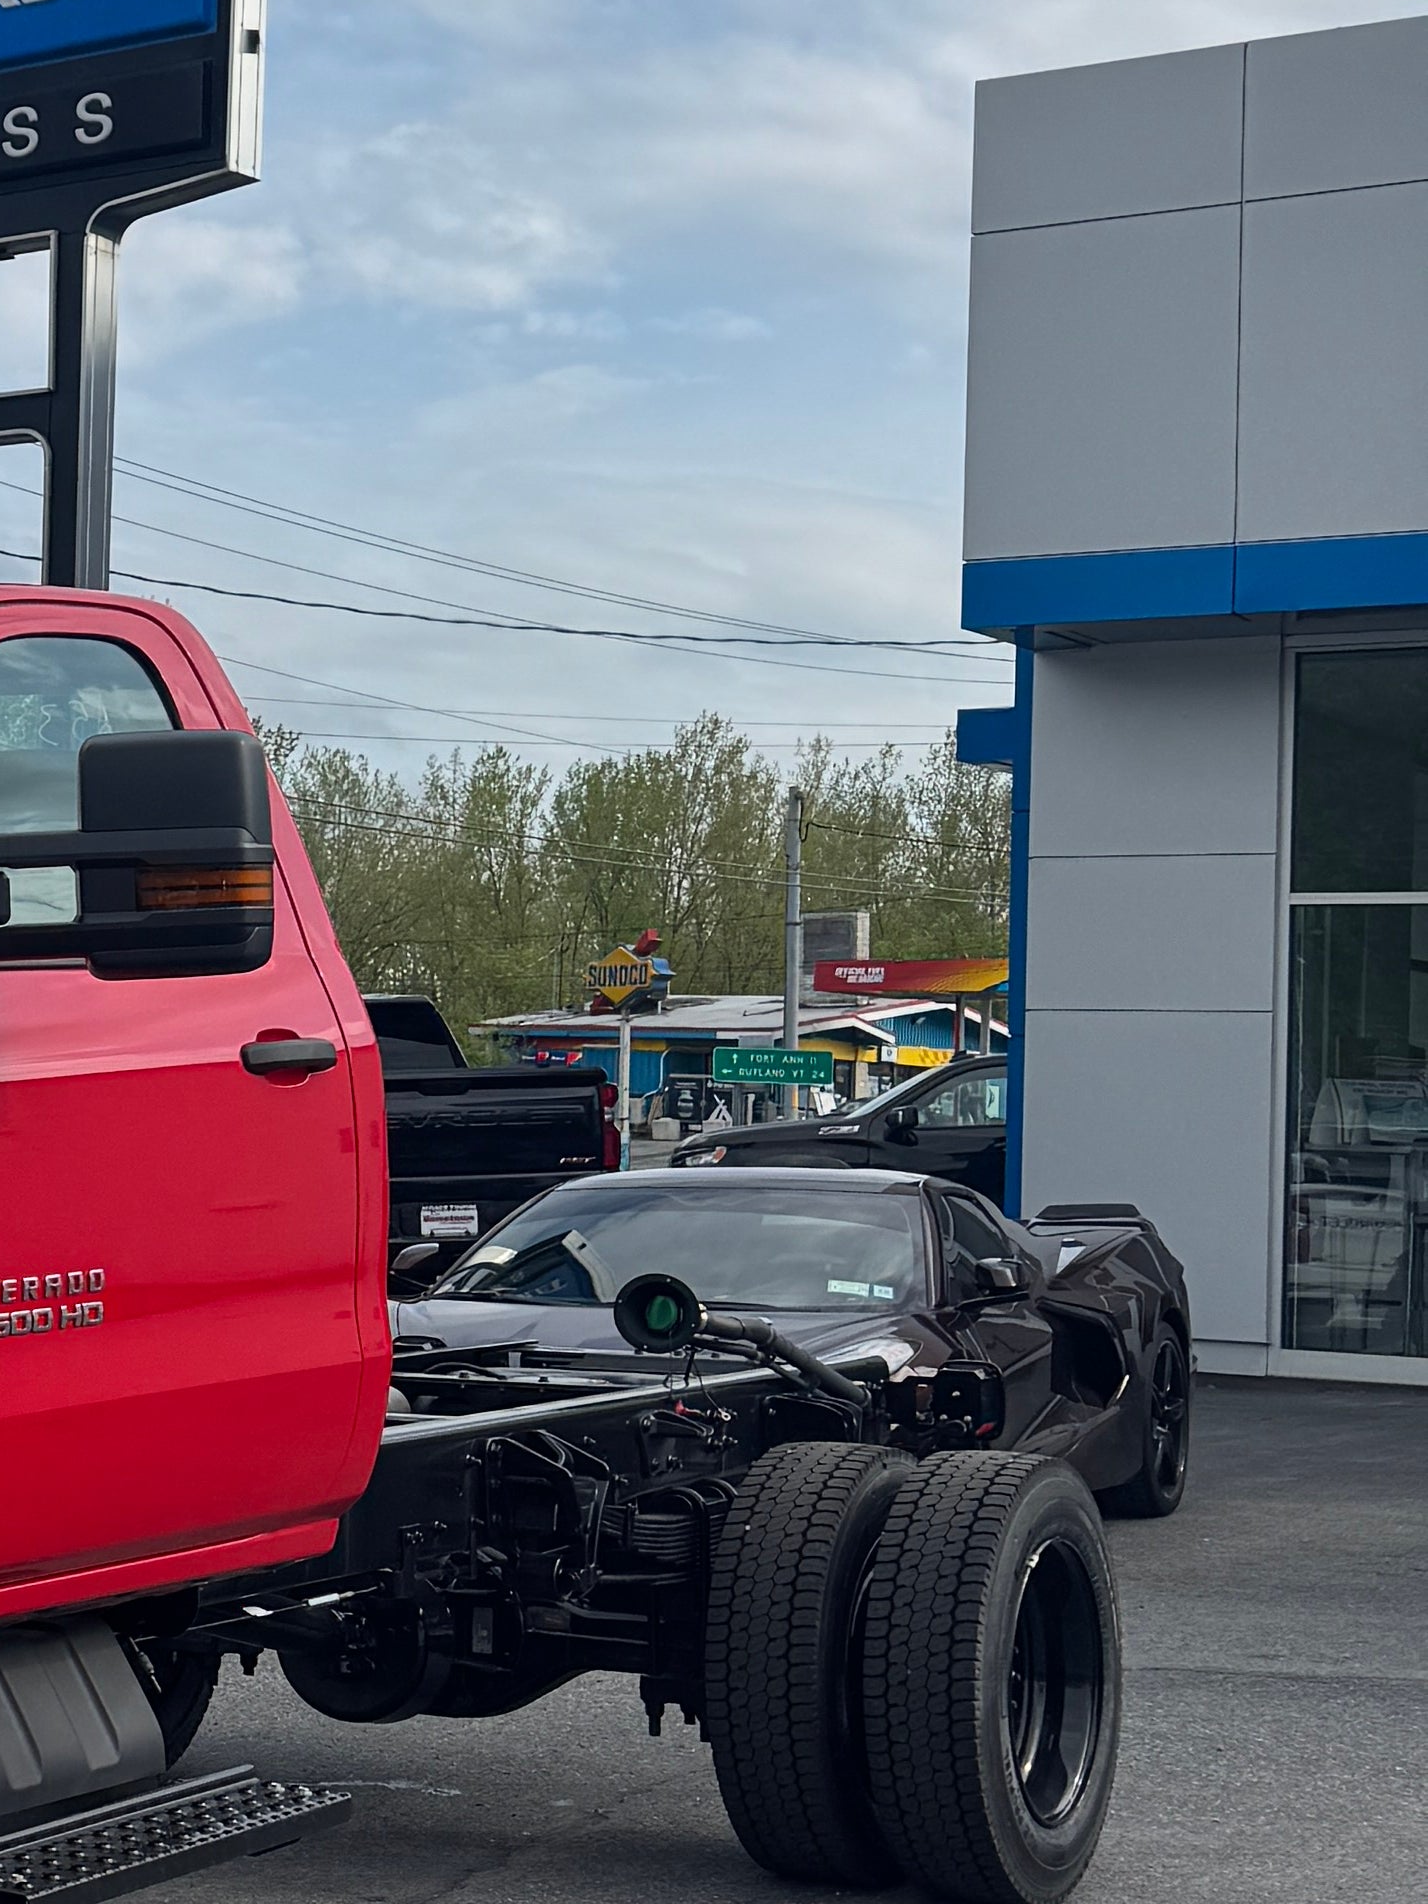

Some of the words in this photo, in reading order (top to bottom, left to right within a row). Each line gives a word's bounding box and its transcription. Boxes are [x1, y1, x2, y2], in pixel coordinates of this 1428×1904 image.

[588, 964, 648, 987] SUNOCO
[750, 1054, 774, 1064] FORT
[782, 1056, 804, 1064] ANN
[739, 1068, 785, 1078] RUTLAND
[792, 1070, 804, 1078] VT
[812, 1071, 824, 1079] 24
[60, 1301, 105, 1329] HD
